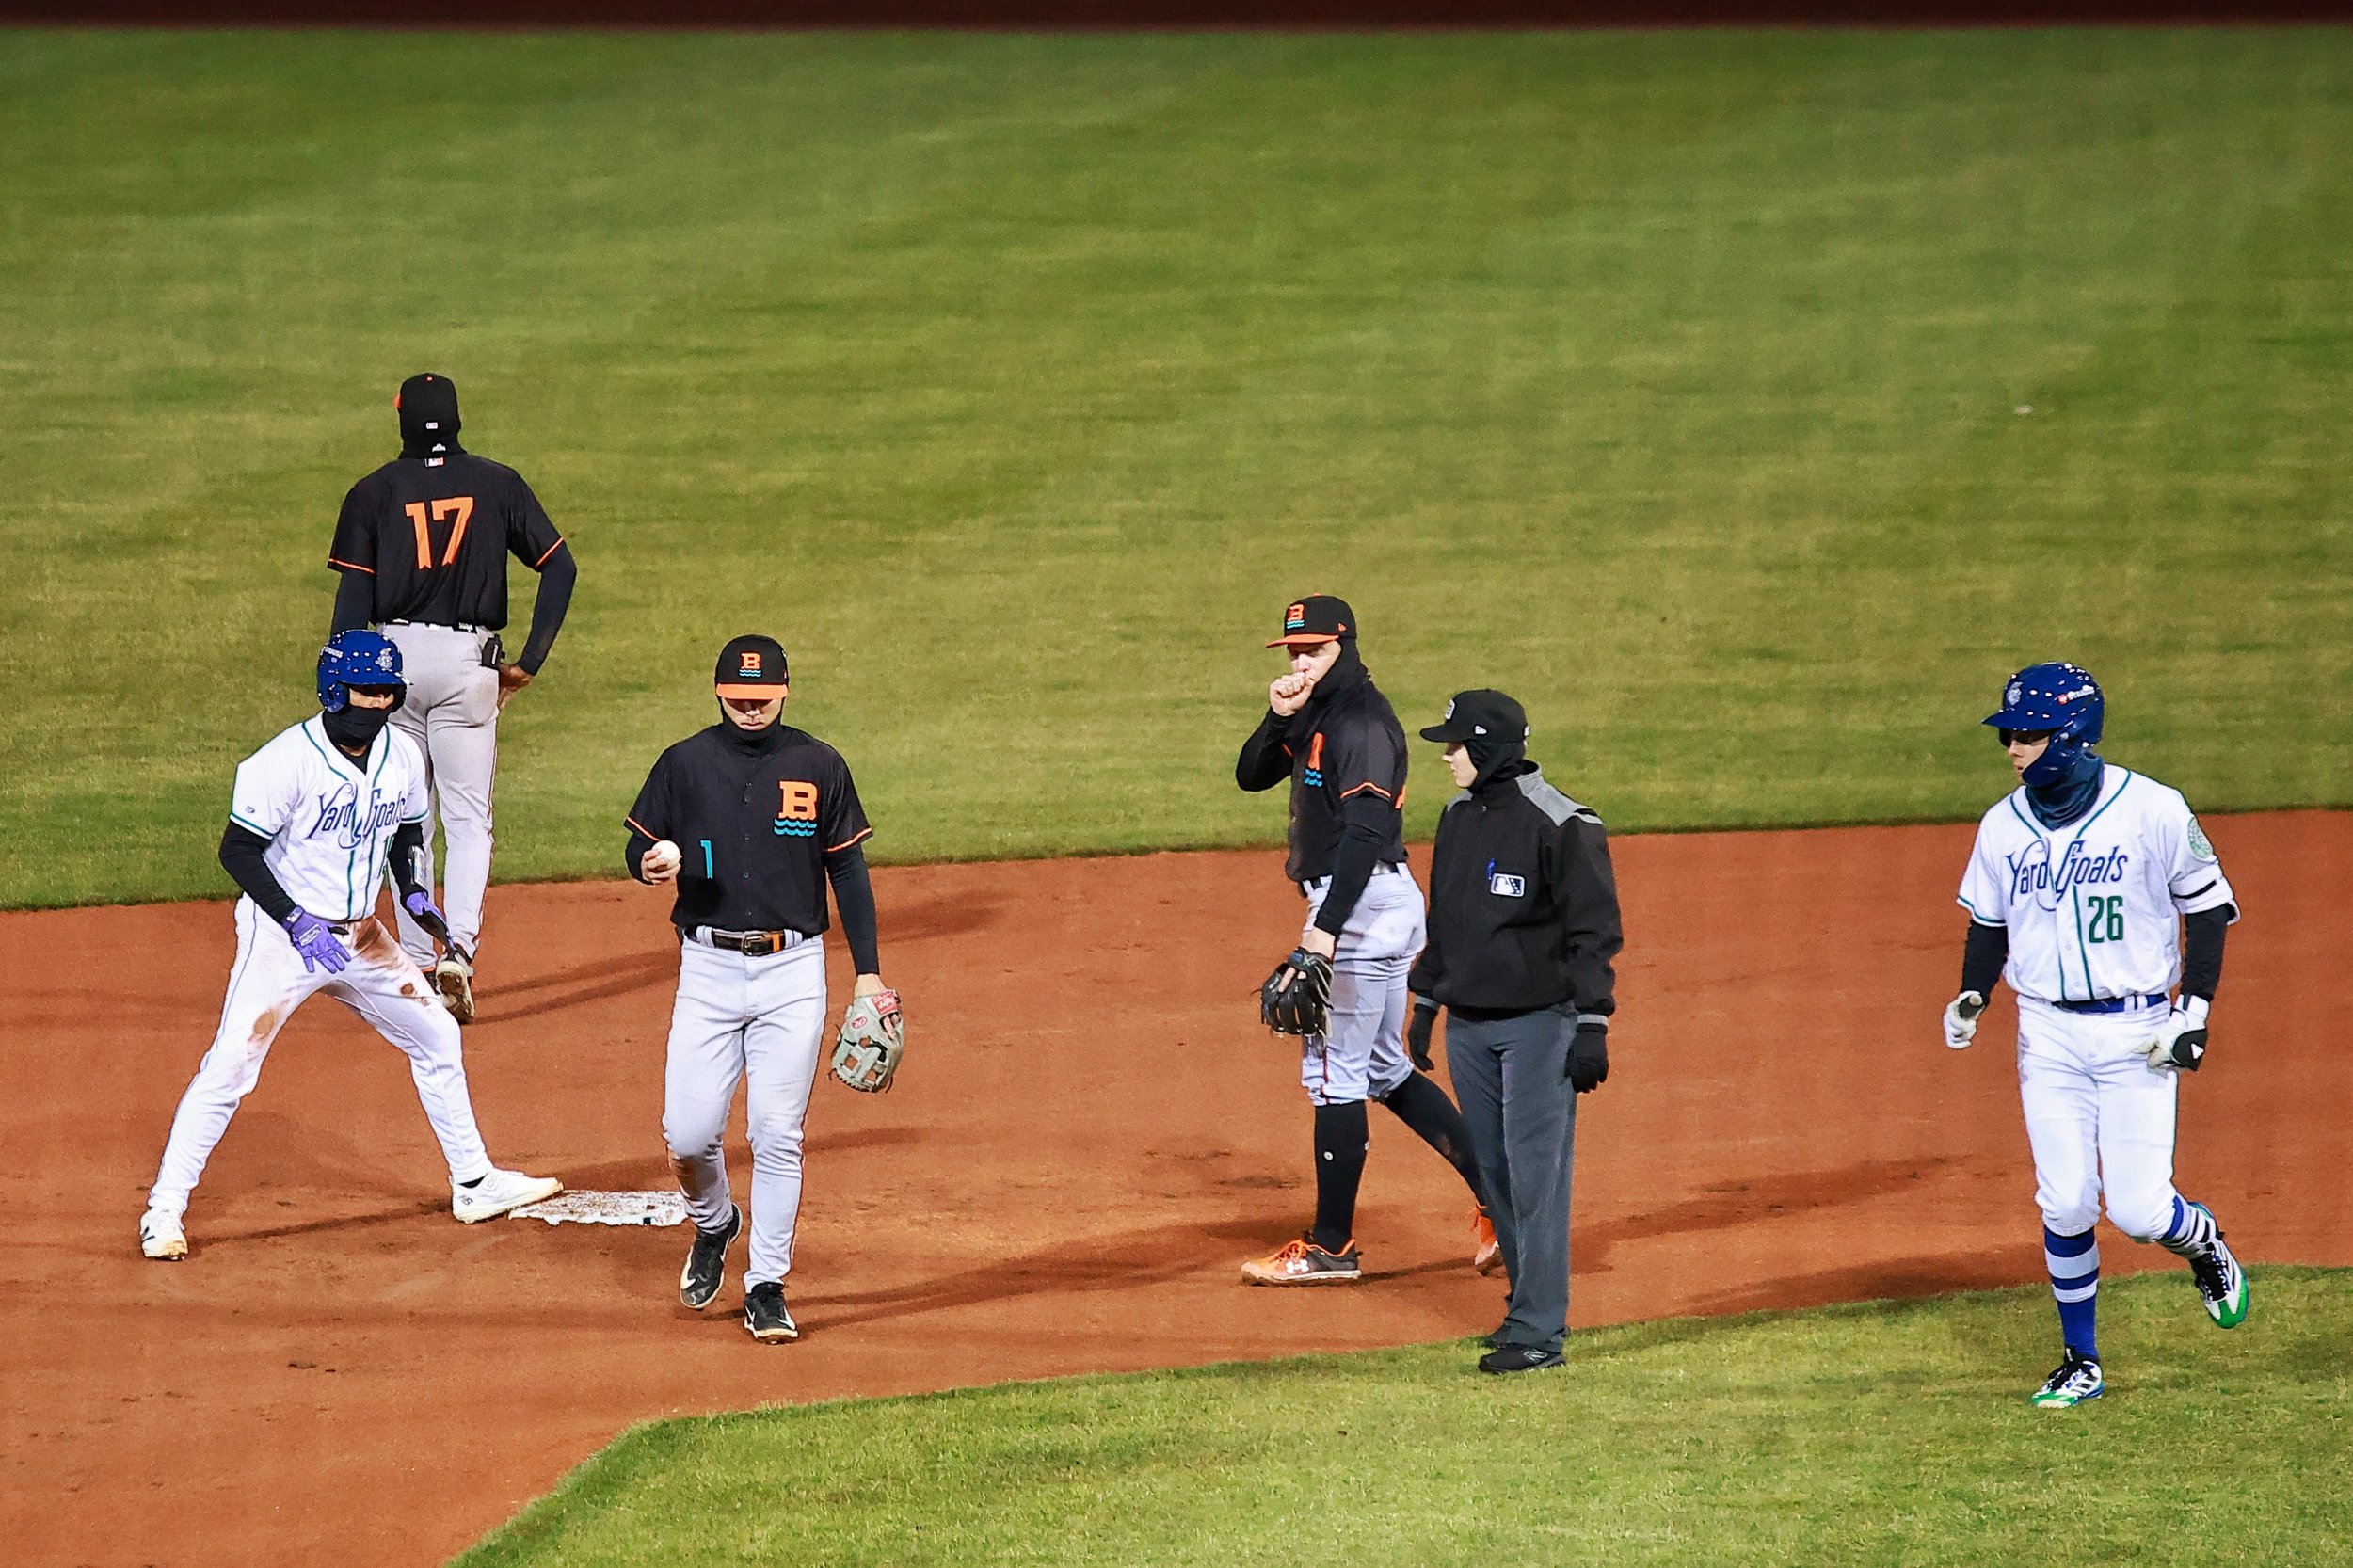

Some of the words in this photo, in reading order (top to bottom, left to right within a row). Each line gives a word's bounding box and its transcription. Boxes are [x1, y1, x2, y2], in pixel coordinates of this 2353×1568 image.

[405, 496, 474, 570] 17
[740, 652, 760, 669] B
[305, 780, 358, 840] Yard
[778, 779, 819, 821] B
[699, 840, 714, 880] 1
[2004, 837, 2052, 906] Yard
[2037, 840, 2128, 911] Goats
[2087, 895, 2125, 944] 26
